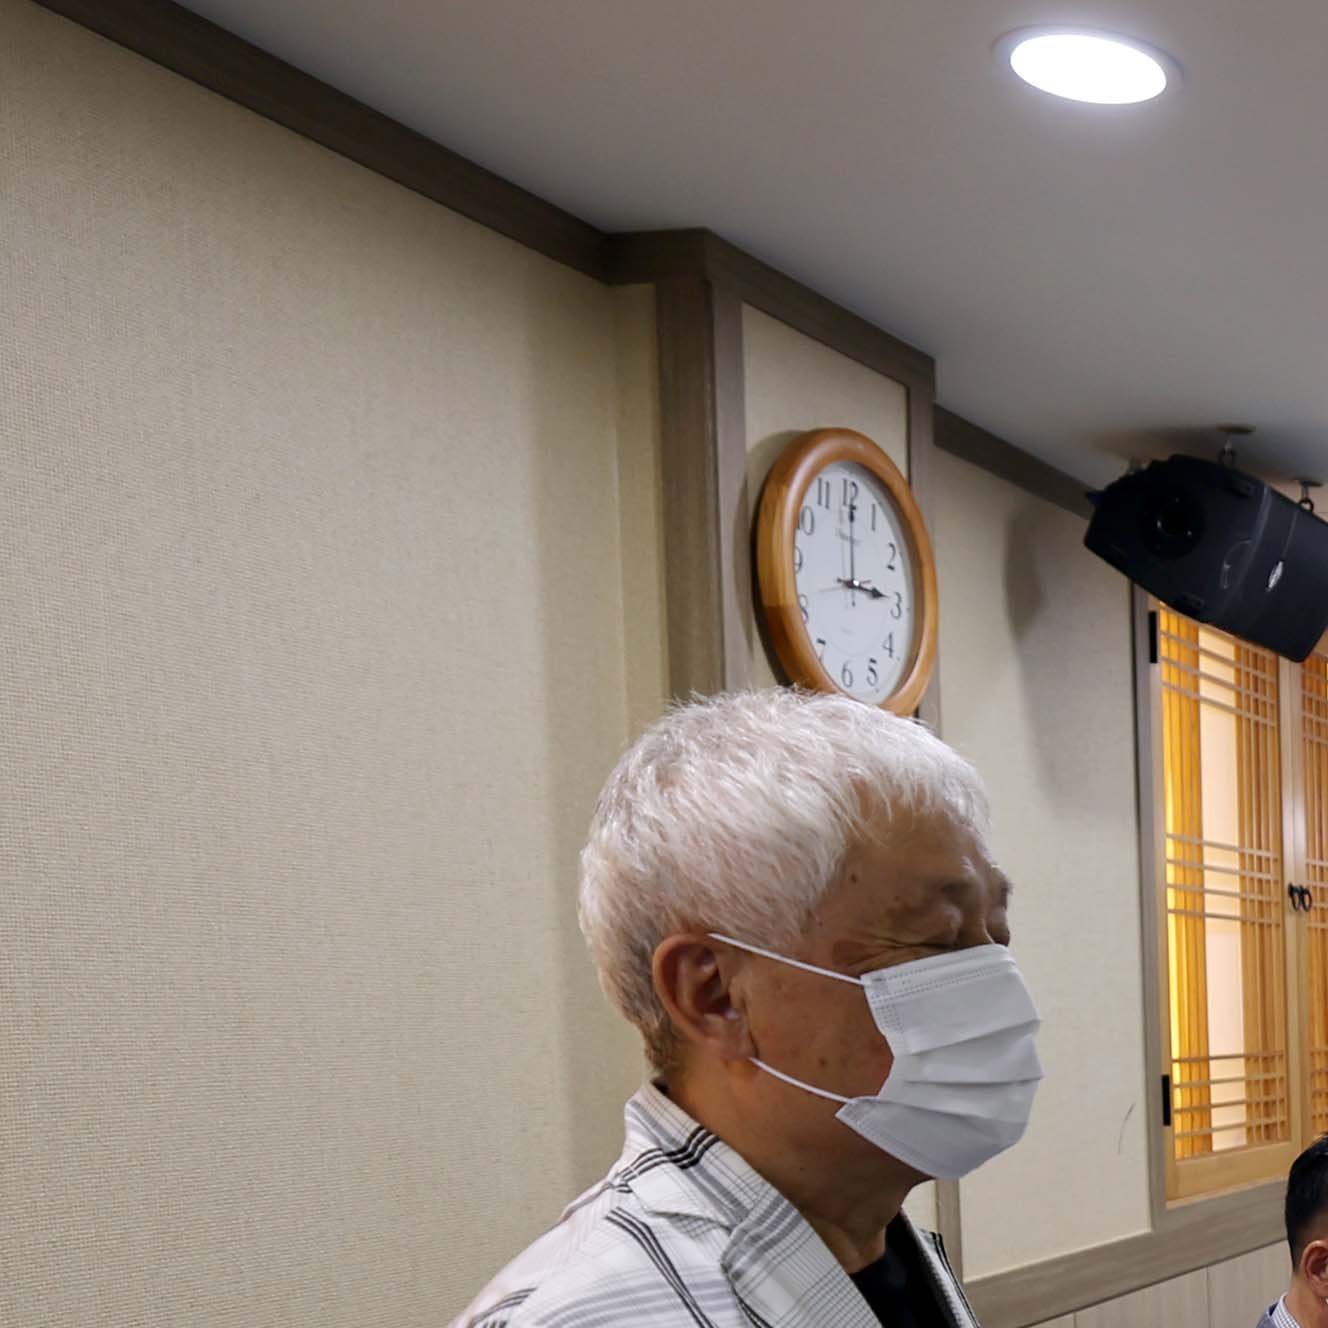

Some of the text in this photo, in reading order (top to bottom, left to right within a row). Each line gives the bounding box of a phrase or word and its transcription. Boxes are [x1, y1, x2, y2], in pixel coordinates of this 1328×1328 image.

[843, 478, 859, 508] 12
[886, 542, 897, 571] 2
[888, 591, 903, 620] 3
[883, 631, 894, 658] 4
[840, 660, 854, 688] 6
[866, 657, 878, 687] 5
